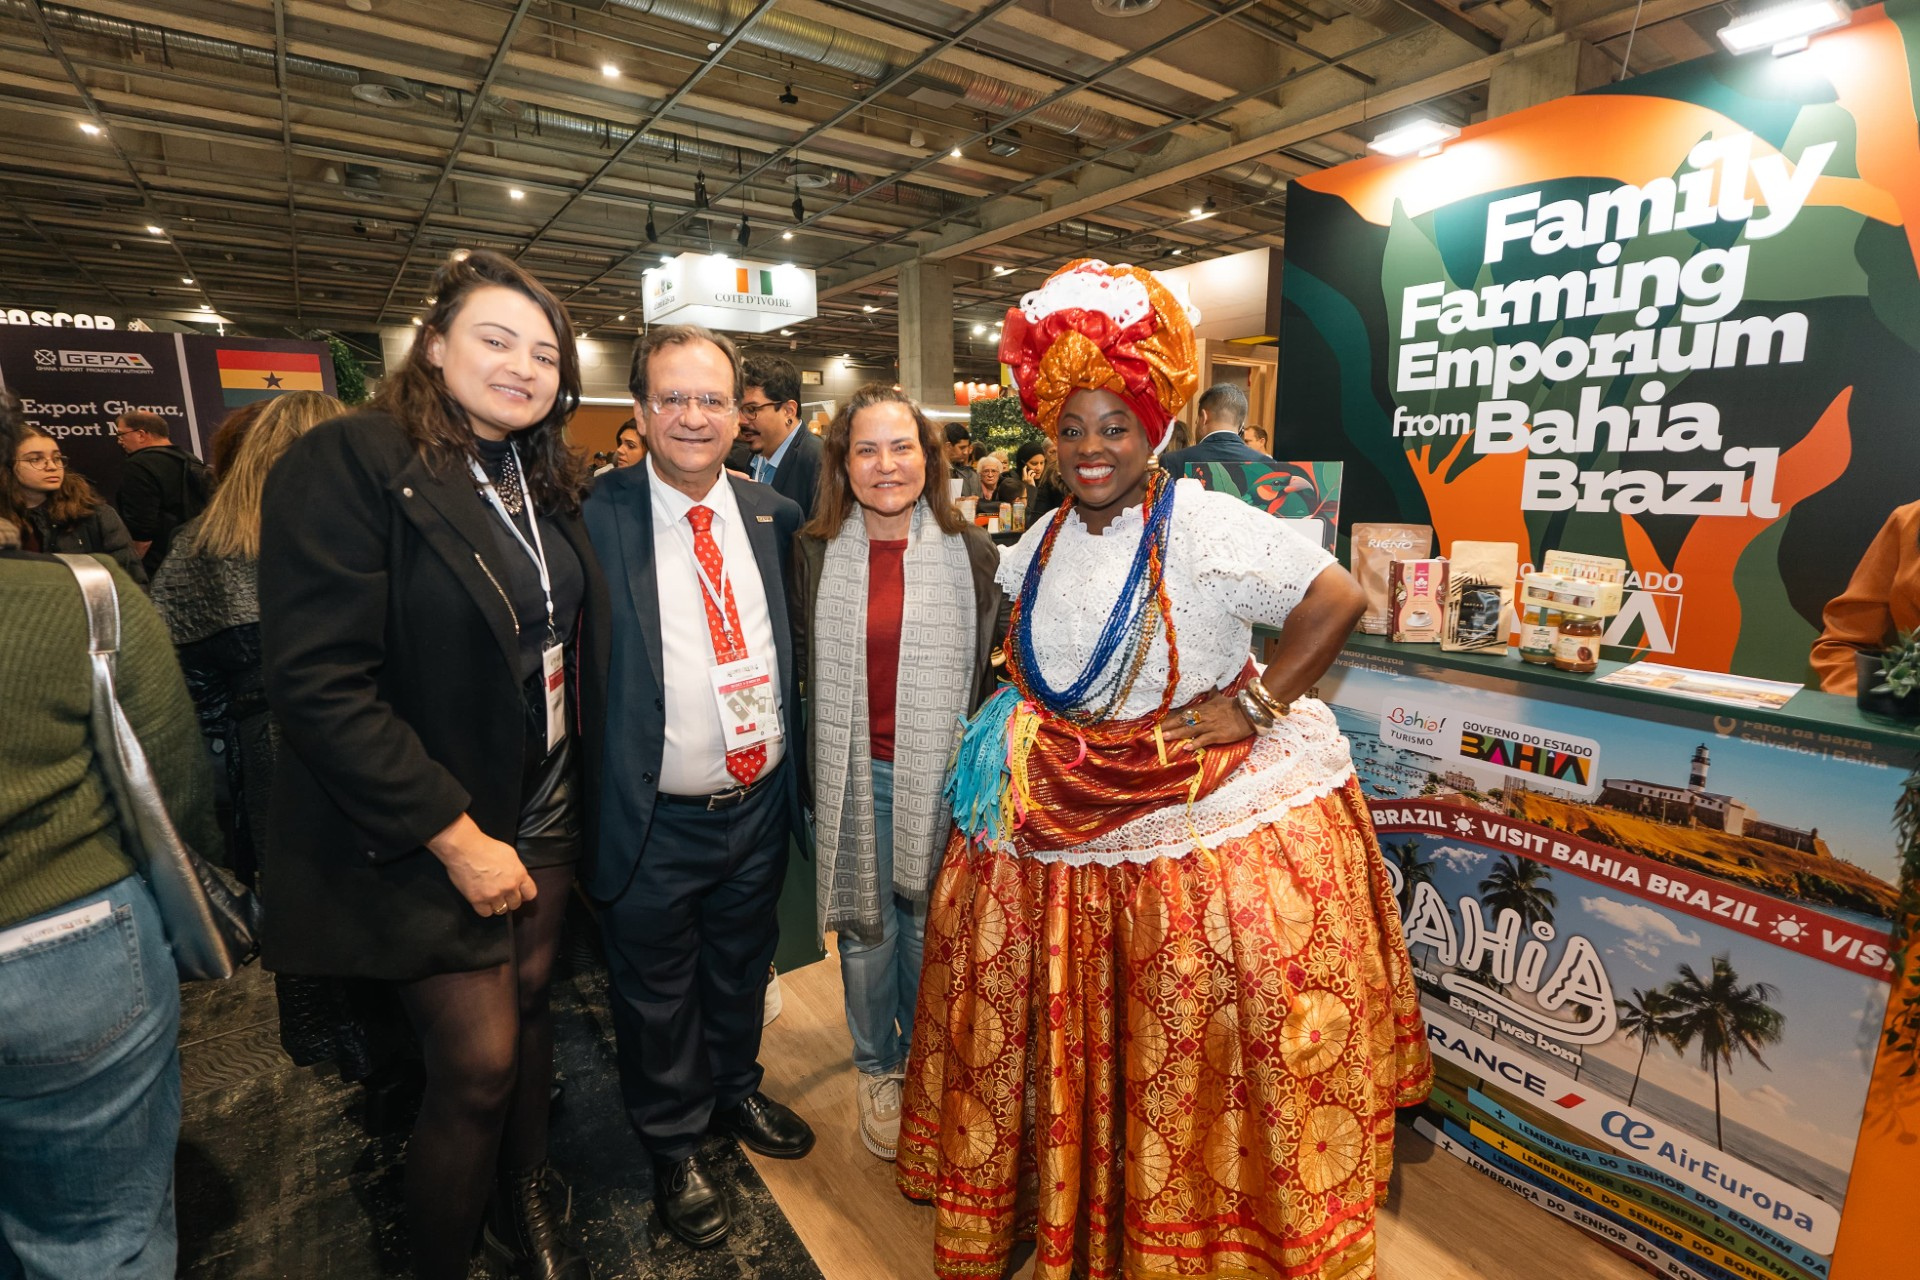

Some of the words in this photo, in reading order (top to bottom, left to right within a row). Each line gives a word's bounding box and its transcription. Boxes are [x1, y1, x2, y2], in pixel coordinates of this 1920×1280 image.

[1483, 131, 1838, 264] Family
[746, 294, 792, 308] D'IVOIRE
[1399, 241, 1750, 339] Farming
[66, 353, 131, 366] GEPA
[1396, 306, 1810, 400] Emporium
[20, 399, 98, 418] Export
[24, 420, 102, 439] xport
[1391, 405, 1471, 438] from
[1473, 380, 1723, 454] Bahia
[1520, 445, 1781, 519] Brazil
[1391, 729, 1433, 746] TURISMO
[1462, 721, 1520, 740] GOVERNO
[1523, 733, 1540, 745] DO
[1543, 738, 1593, 757] ESTADO
[1740, 732, 1818, 757] Salvador
[1832, 749, 1888, 770] Bahia
[1371, 808, 1448, 829] BRAZIL
[1481, 820, 1549, 854] VISIT
[1551, 841, 1641, 888] BAHIA
[1646, 872, 1761, 928] BRAZIL
[1424, 1020, 1547, 1097] RANCE
[1449, 995, 1499, 1028] Brazil
[1500, 1020, 1535, 1045] was
[1536, 1033, 1582, 1066] born
[1466, 1155, 1540, 1201] LEMBRANÇA
[1546, 1198, 1566, 1213] DO
[1574, 1210, 1628, 1243] SENHOR
[1635, 1241, 1659, 1260] DO
[1519, 1122, 1591, 1162] LEMBRANÇA
[1598, 1156, 1619, 1169] DO
[1627, 1164, 1686, 1194] SENHOR
[1694, 1191, 1719, 1210] DO
[1727, 1210, 1793, 1254] BONFIM
[1801, 1255, 1827, 1276] DA
[1522, 1152, 1594, 1197] LEMBRANÇA
[1601, 1193, 1620, 1209] DO
[1628, 1207, 1684, 1242] SENHOR
[1692, 1240, 1715, 1257] DO
[1623, 1184, 1643, 1198] DO
[1651, 1196, 1706, 1229] BONFIM
[1714, 1227, 1736, 1246] DA
[1657, 1141, 1814, 1233] AirEuropa
